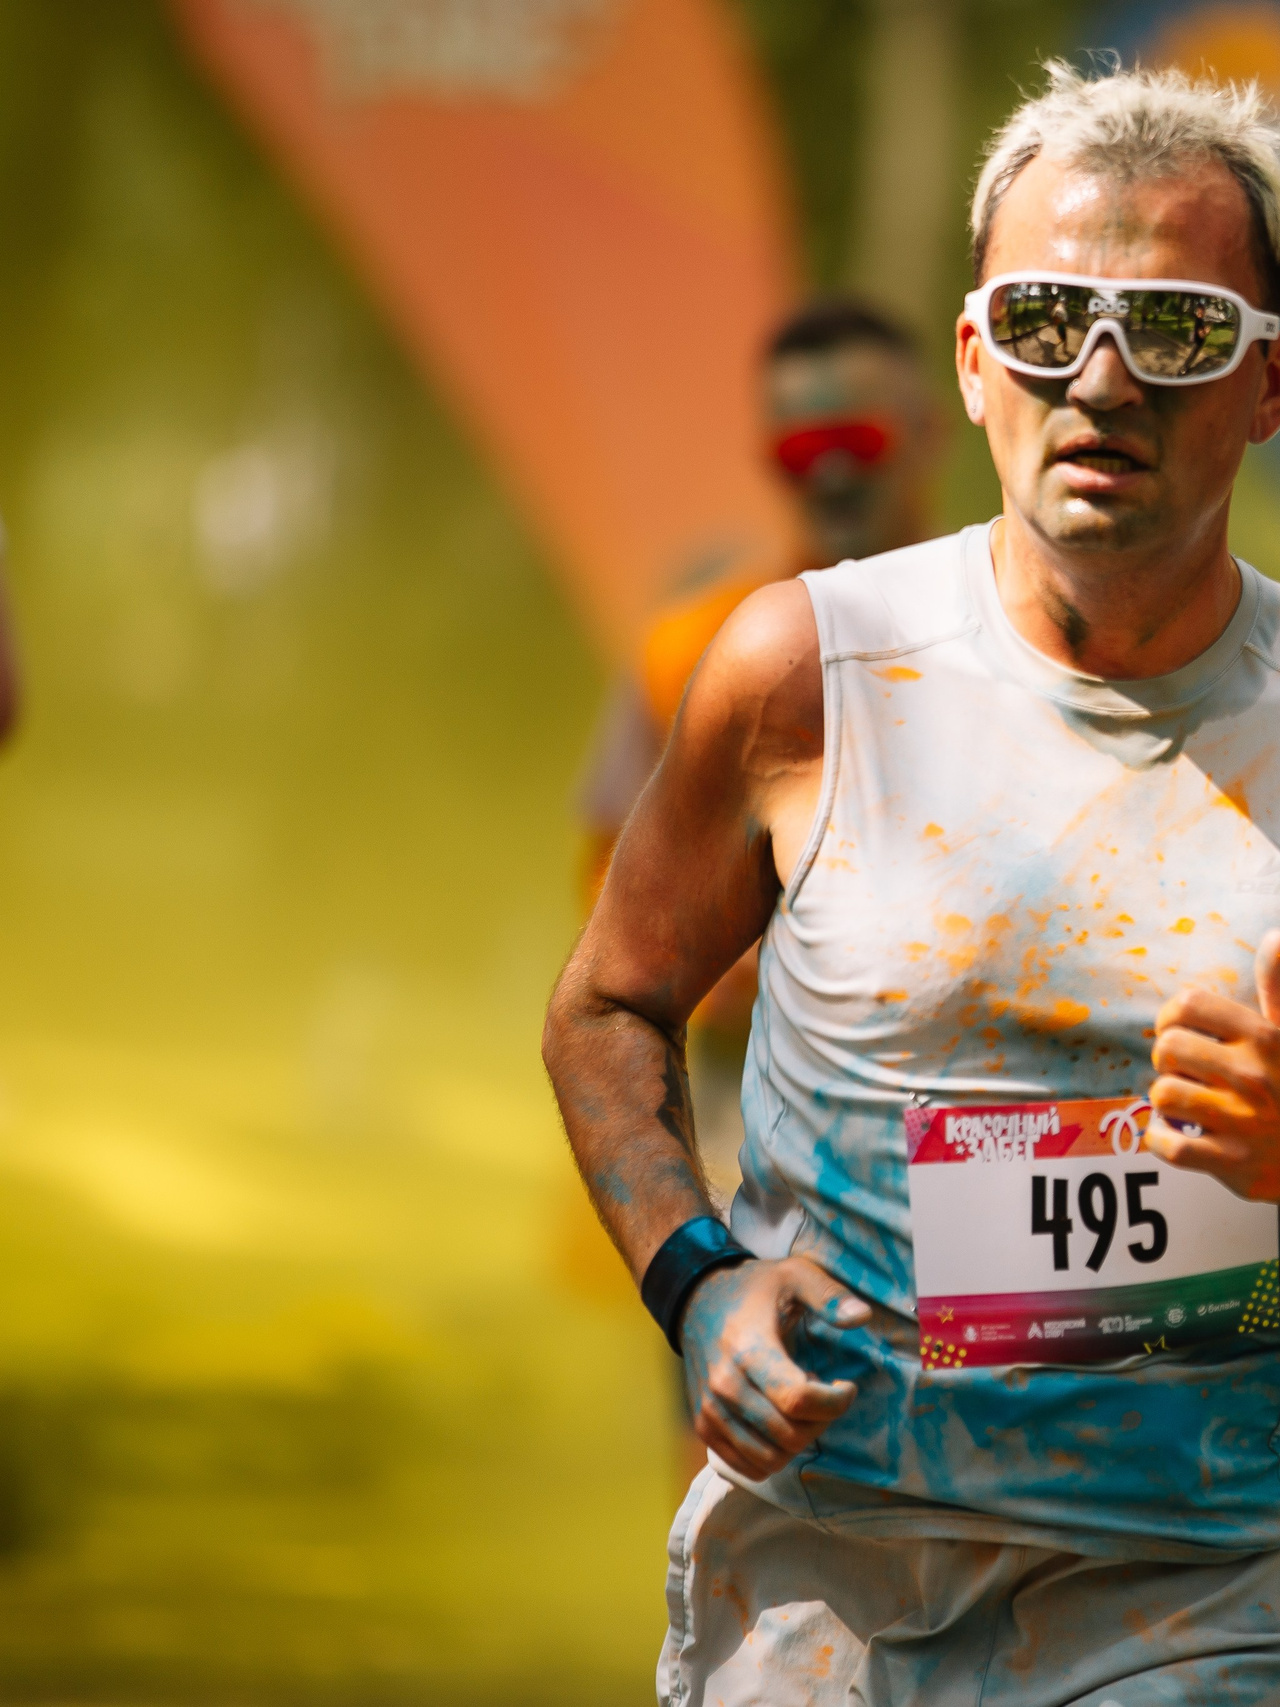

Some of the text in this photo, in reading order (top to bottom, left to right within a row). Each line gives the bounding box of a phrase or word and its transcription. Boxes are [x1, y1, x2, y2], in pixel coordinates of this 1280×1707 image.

[945, 1106, 1060, 1144] КРАСОЧНЫЙ
[965, 1134, 1040, 1163] ЗАБЕГ
[1031, 1171, 1168, 1273] 495
